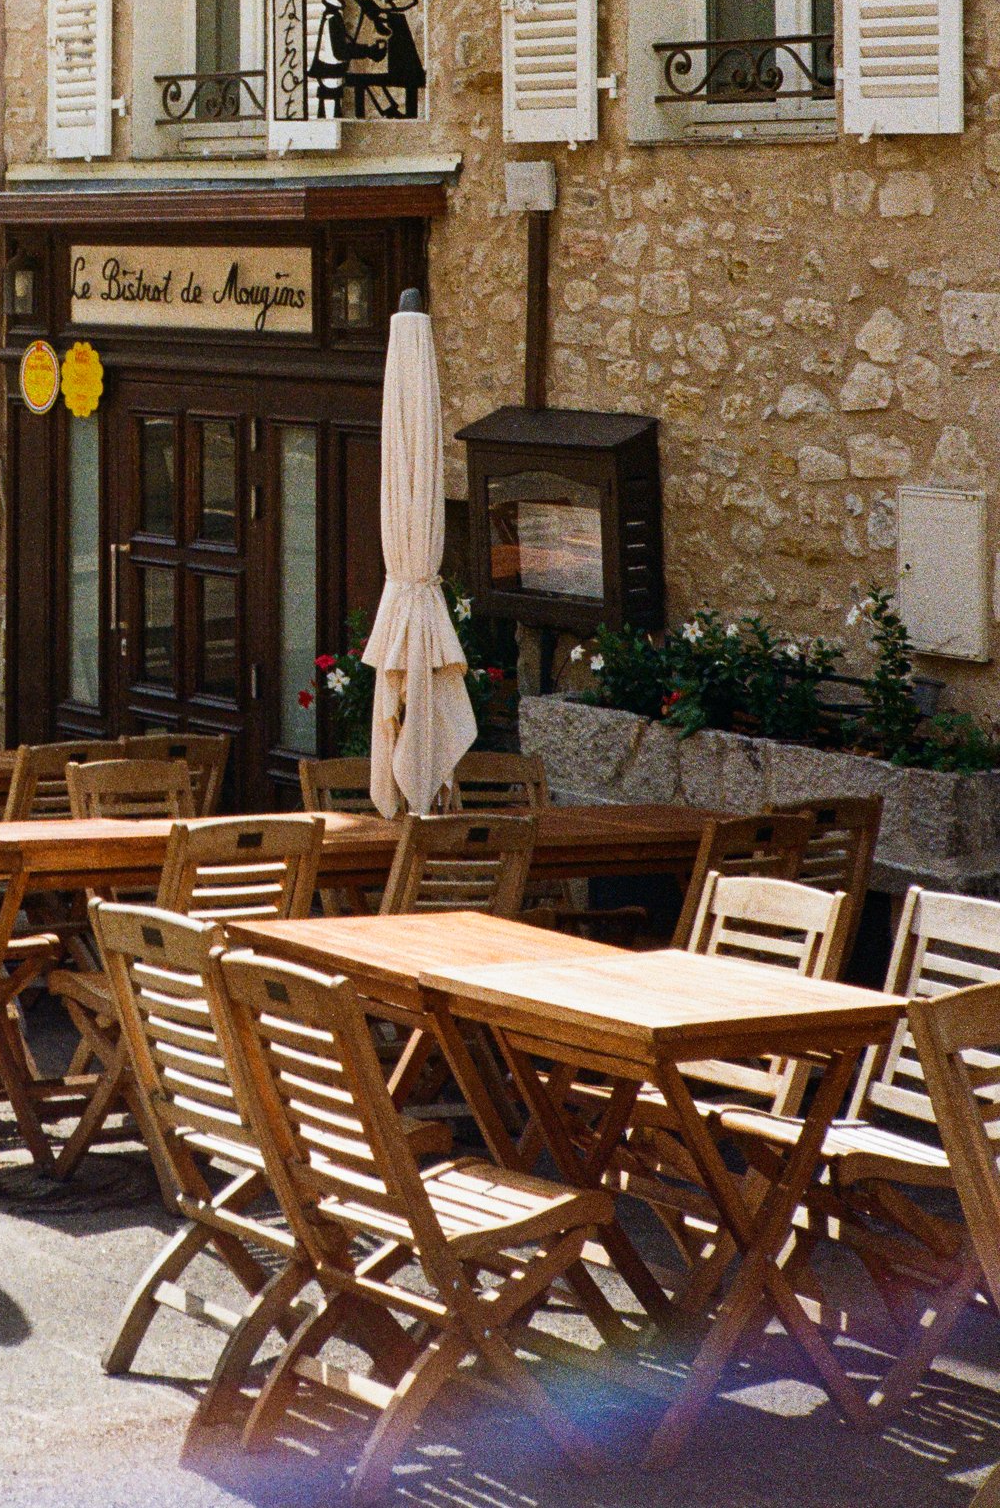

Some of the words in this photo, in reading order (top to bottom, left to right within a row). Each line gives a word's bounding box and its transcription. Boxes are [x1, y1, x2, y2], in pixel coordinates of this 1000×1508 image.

[71, 256, 92, 301] Le
[100, 257, 173, 304] Bistrot
[181, 271, 202, 304] de
[213, 261, 306, 333] Mougins
